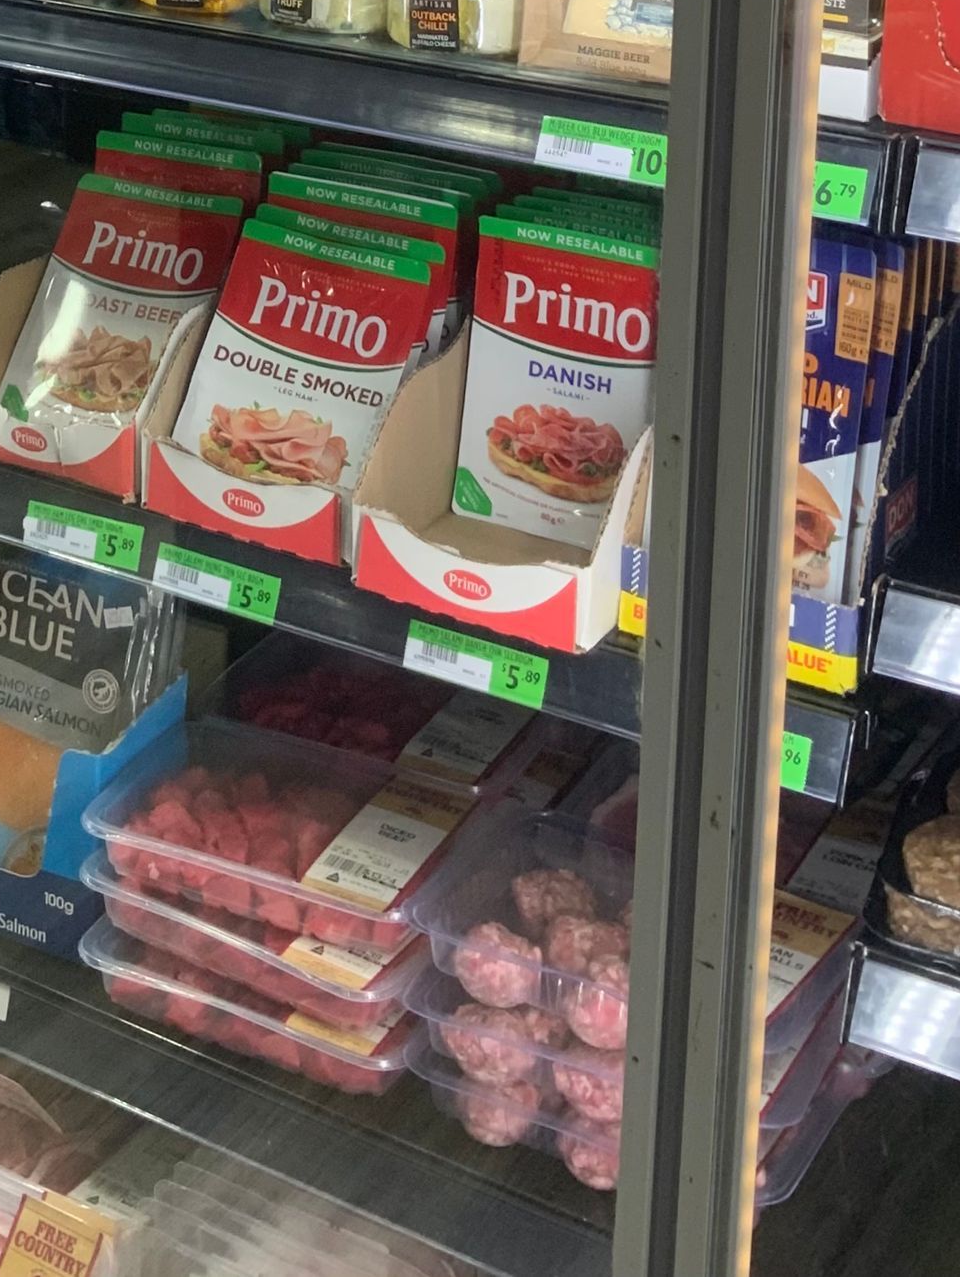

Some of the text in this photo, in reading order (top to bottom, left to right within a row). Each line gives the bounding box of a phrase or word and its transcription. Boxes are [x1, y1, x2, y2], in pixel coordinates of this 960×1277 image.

[411, 10, 456, 22] OUTBACK
[418, 20, 448, 31] CHILLI
[577, 44, 650, 64] MAGGIE BEER
[155, 123, 182, 134] NOW
[134, 140, 234, 164] NOW RESEALABLE
[114, 182, 215, 208] NOW RESEALABLE
[306, 186, 422, 218] NOW RESEALABLE
[297, 215, 409, 251] NOW RESEALABLE
[517, 227, 644, 262] NOW RESEALABLE
[83, 220, 204, 285] Primo
[285, 234, 395, 271] NOW RESEALABLE
[846, 277, 872, 291] MILD
[134, 305, 182, 324] BEEF
[248, 275, 388, 359] Primo
[503, 270, 651, 354] Primo
[214, 344, 384, 408] DOUBLE SMOKED
[528, 360, 612, 394] DANISH
[552, 387, 585, 401] SALAMI
[15, 431, 46, 451] Primo
[227, 492, 262, 515] Primo
[102, 533, 135, 558] $5.89
[237, 582, 271, 608] $5.89
[448, 573, 488, 598] Primo
[786, 648, 828, 673] ALUE
[502, 662, 541, 690] $5.89
[35, 704, 102, 737] SALMON
[45, 891, 74, 916] 100g
[34, 1219, 78, 1253] FREE
[15, 1229, 88, 1275] COUNTRY
